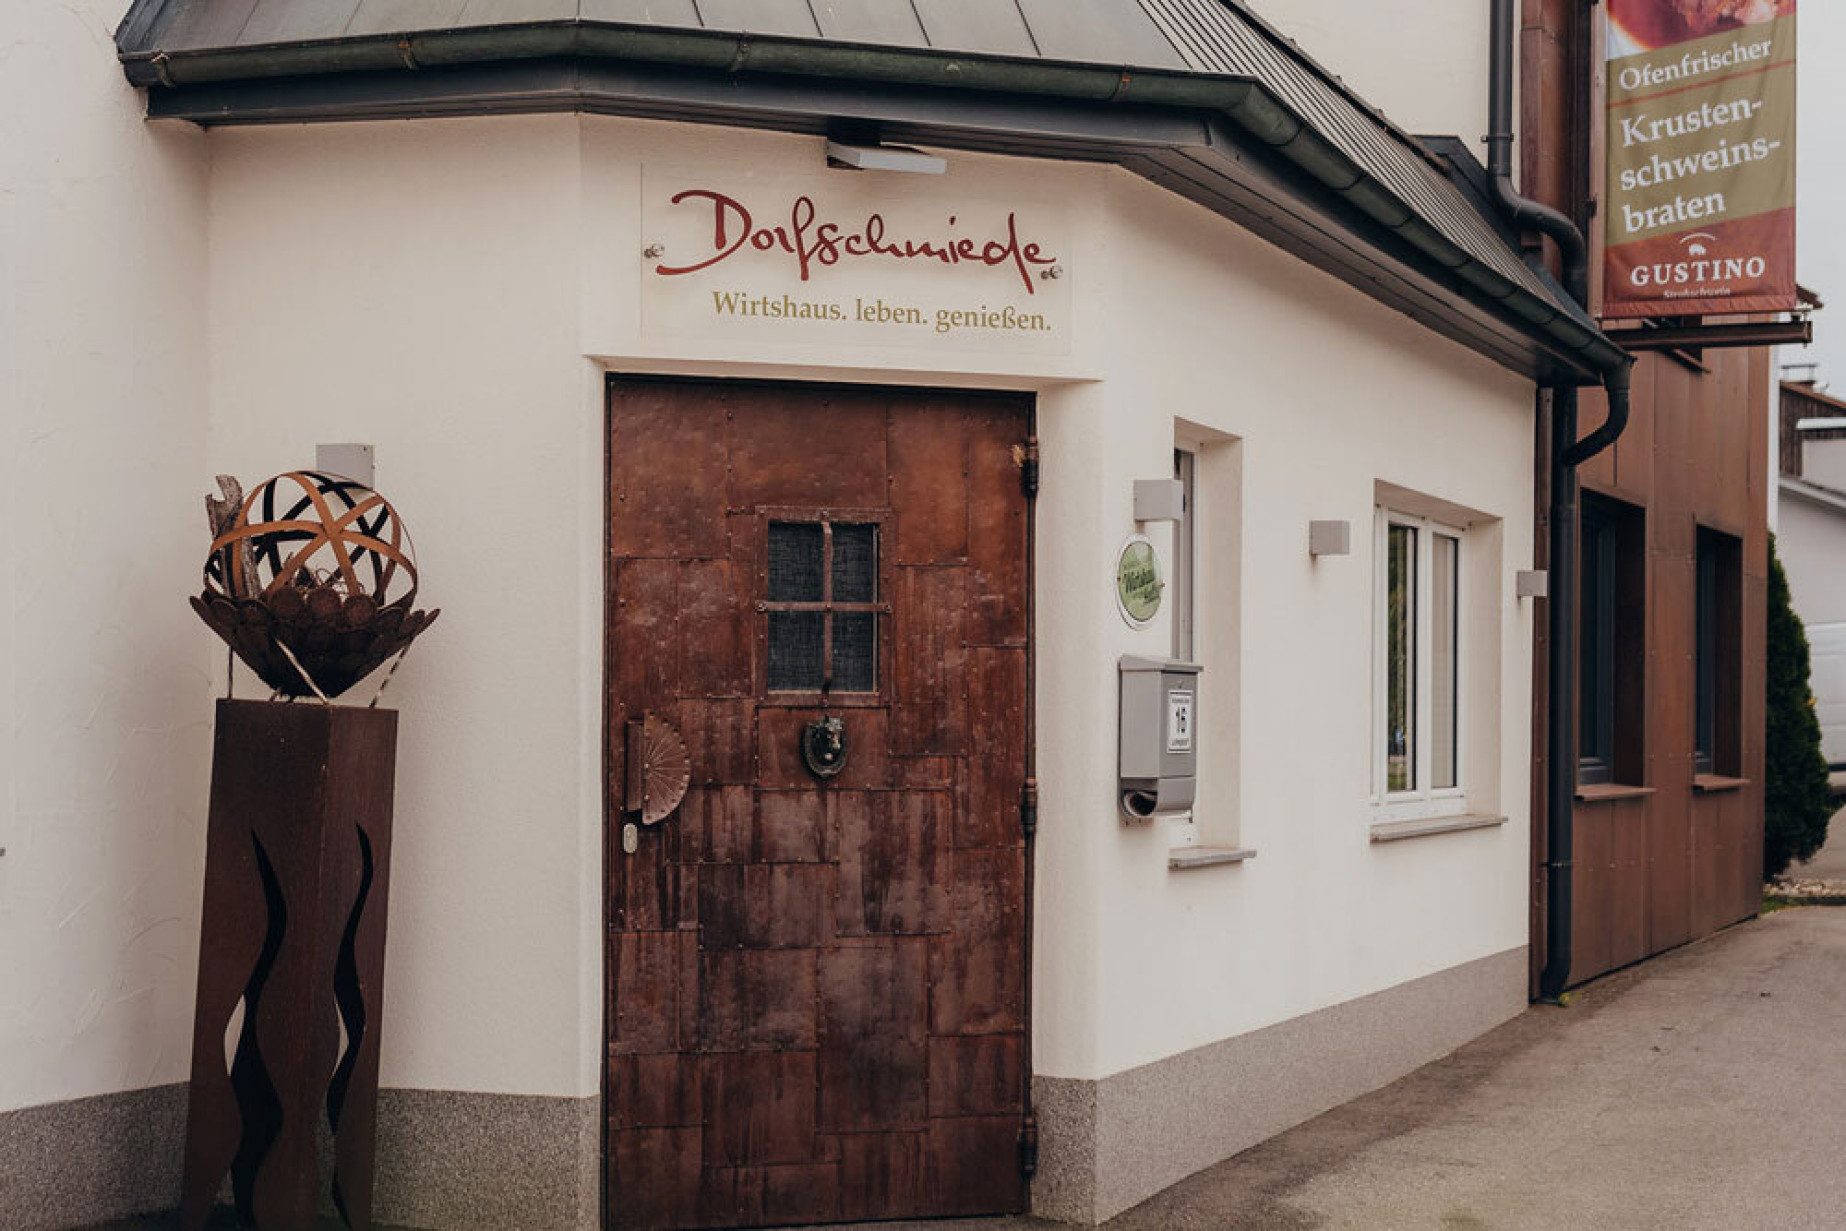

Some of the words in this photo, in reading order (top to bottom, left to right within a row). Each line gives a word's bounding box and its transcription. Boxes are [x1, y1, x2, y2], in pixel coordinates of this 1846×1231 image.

[1619, 40, 1772, 90] Ofenfrischer
[1620, 98, 1763, 148] Krusten-
[1619, 137, 1781, 191] schweins-
[1621, 192, 1727, 233] braten
[656, 189, 1056, 294] Dorfschmiede
[1630, 256, 1766, 287] GUSTINO
[713, 291, 847, 321] Wirtshaus.
[856, 299, 928, 325] leben.
[935, 305, 1052, 333] genießen.
